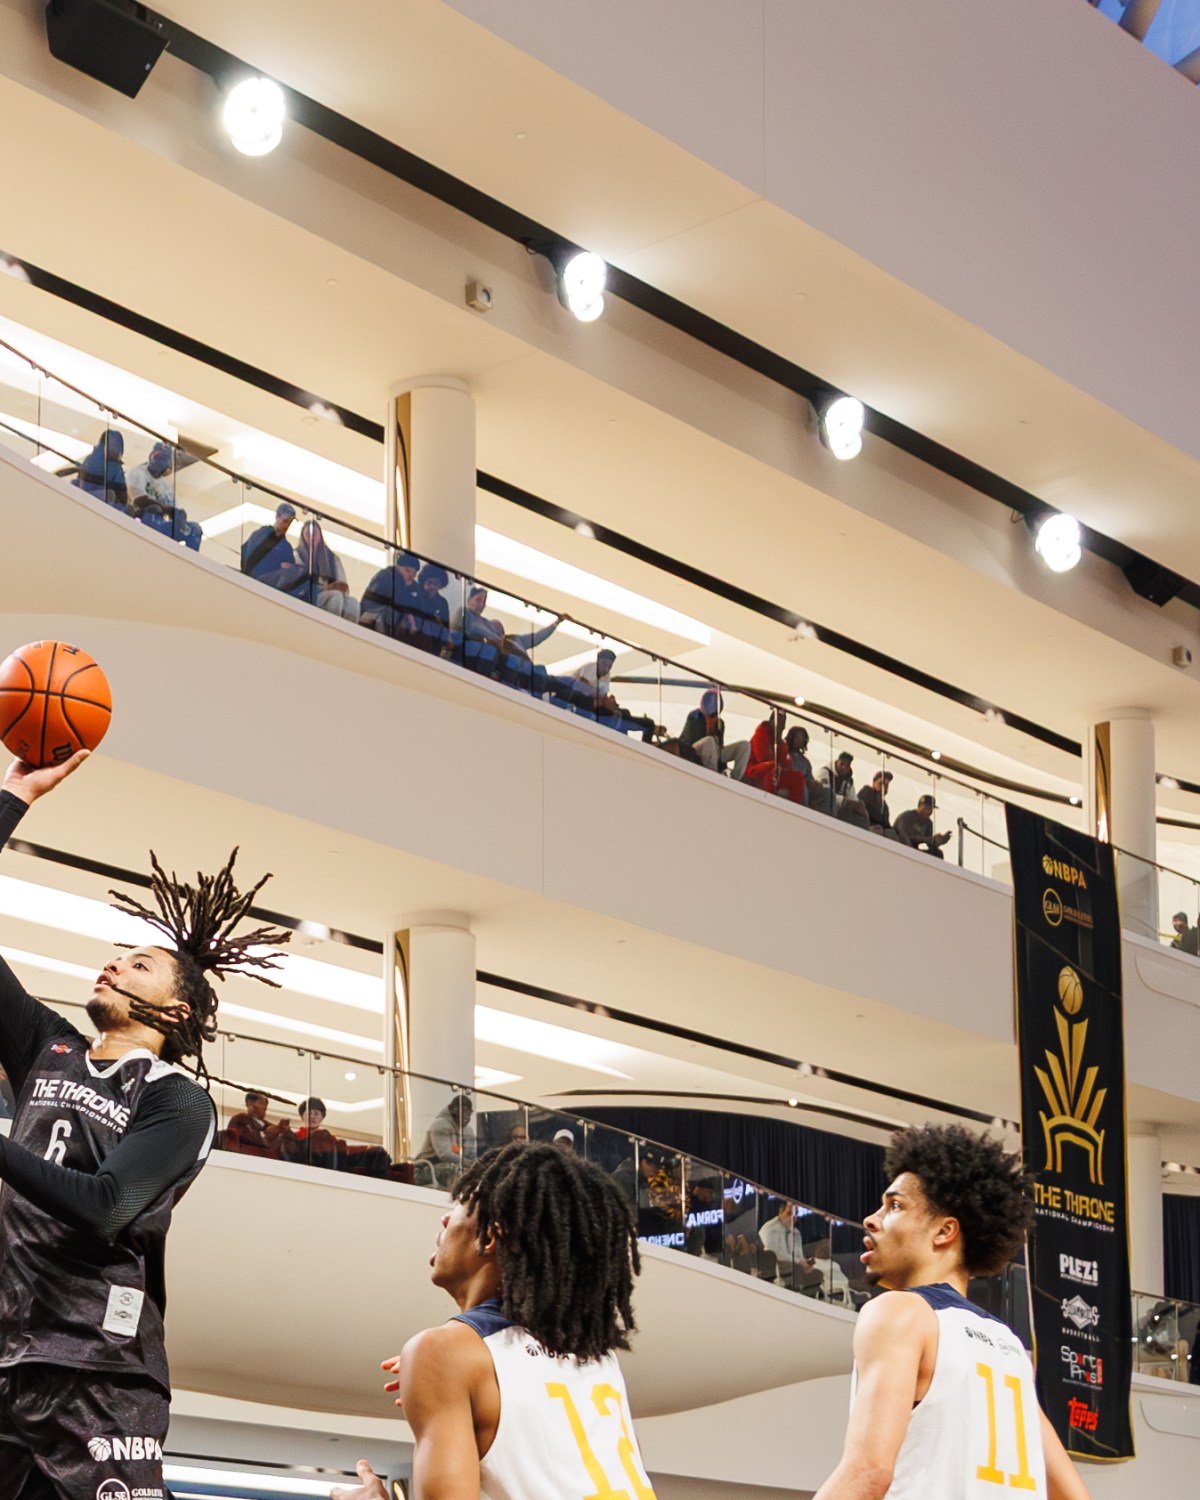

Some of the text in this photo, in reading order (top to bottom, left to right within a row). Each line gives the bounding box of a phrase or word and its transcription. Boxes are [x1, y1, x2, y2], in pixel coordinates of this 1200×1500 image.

[1053, 860, 1087, 889] NBPA
[32, 1078, 131, 1127] THE THRONE
[43, 1119, 72, 1167] 6
[1033, 1182, 1115, 1224] THE THRONE
[1035, 1207, 1069, 1221] NATIONAL
[976, 1362, 1036, 1491] 11
[112, 1436, 163, 1460] NBPA
